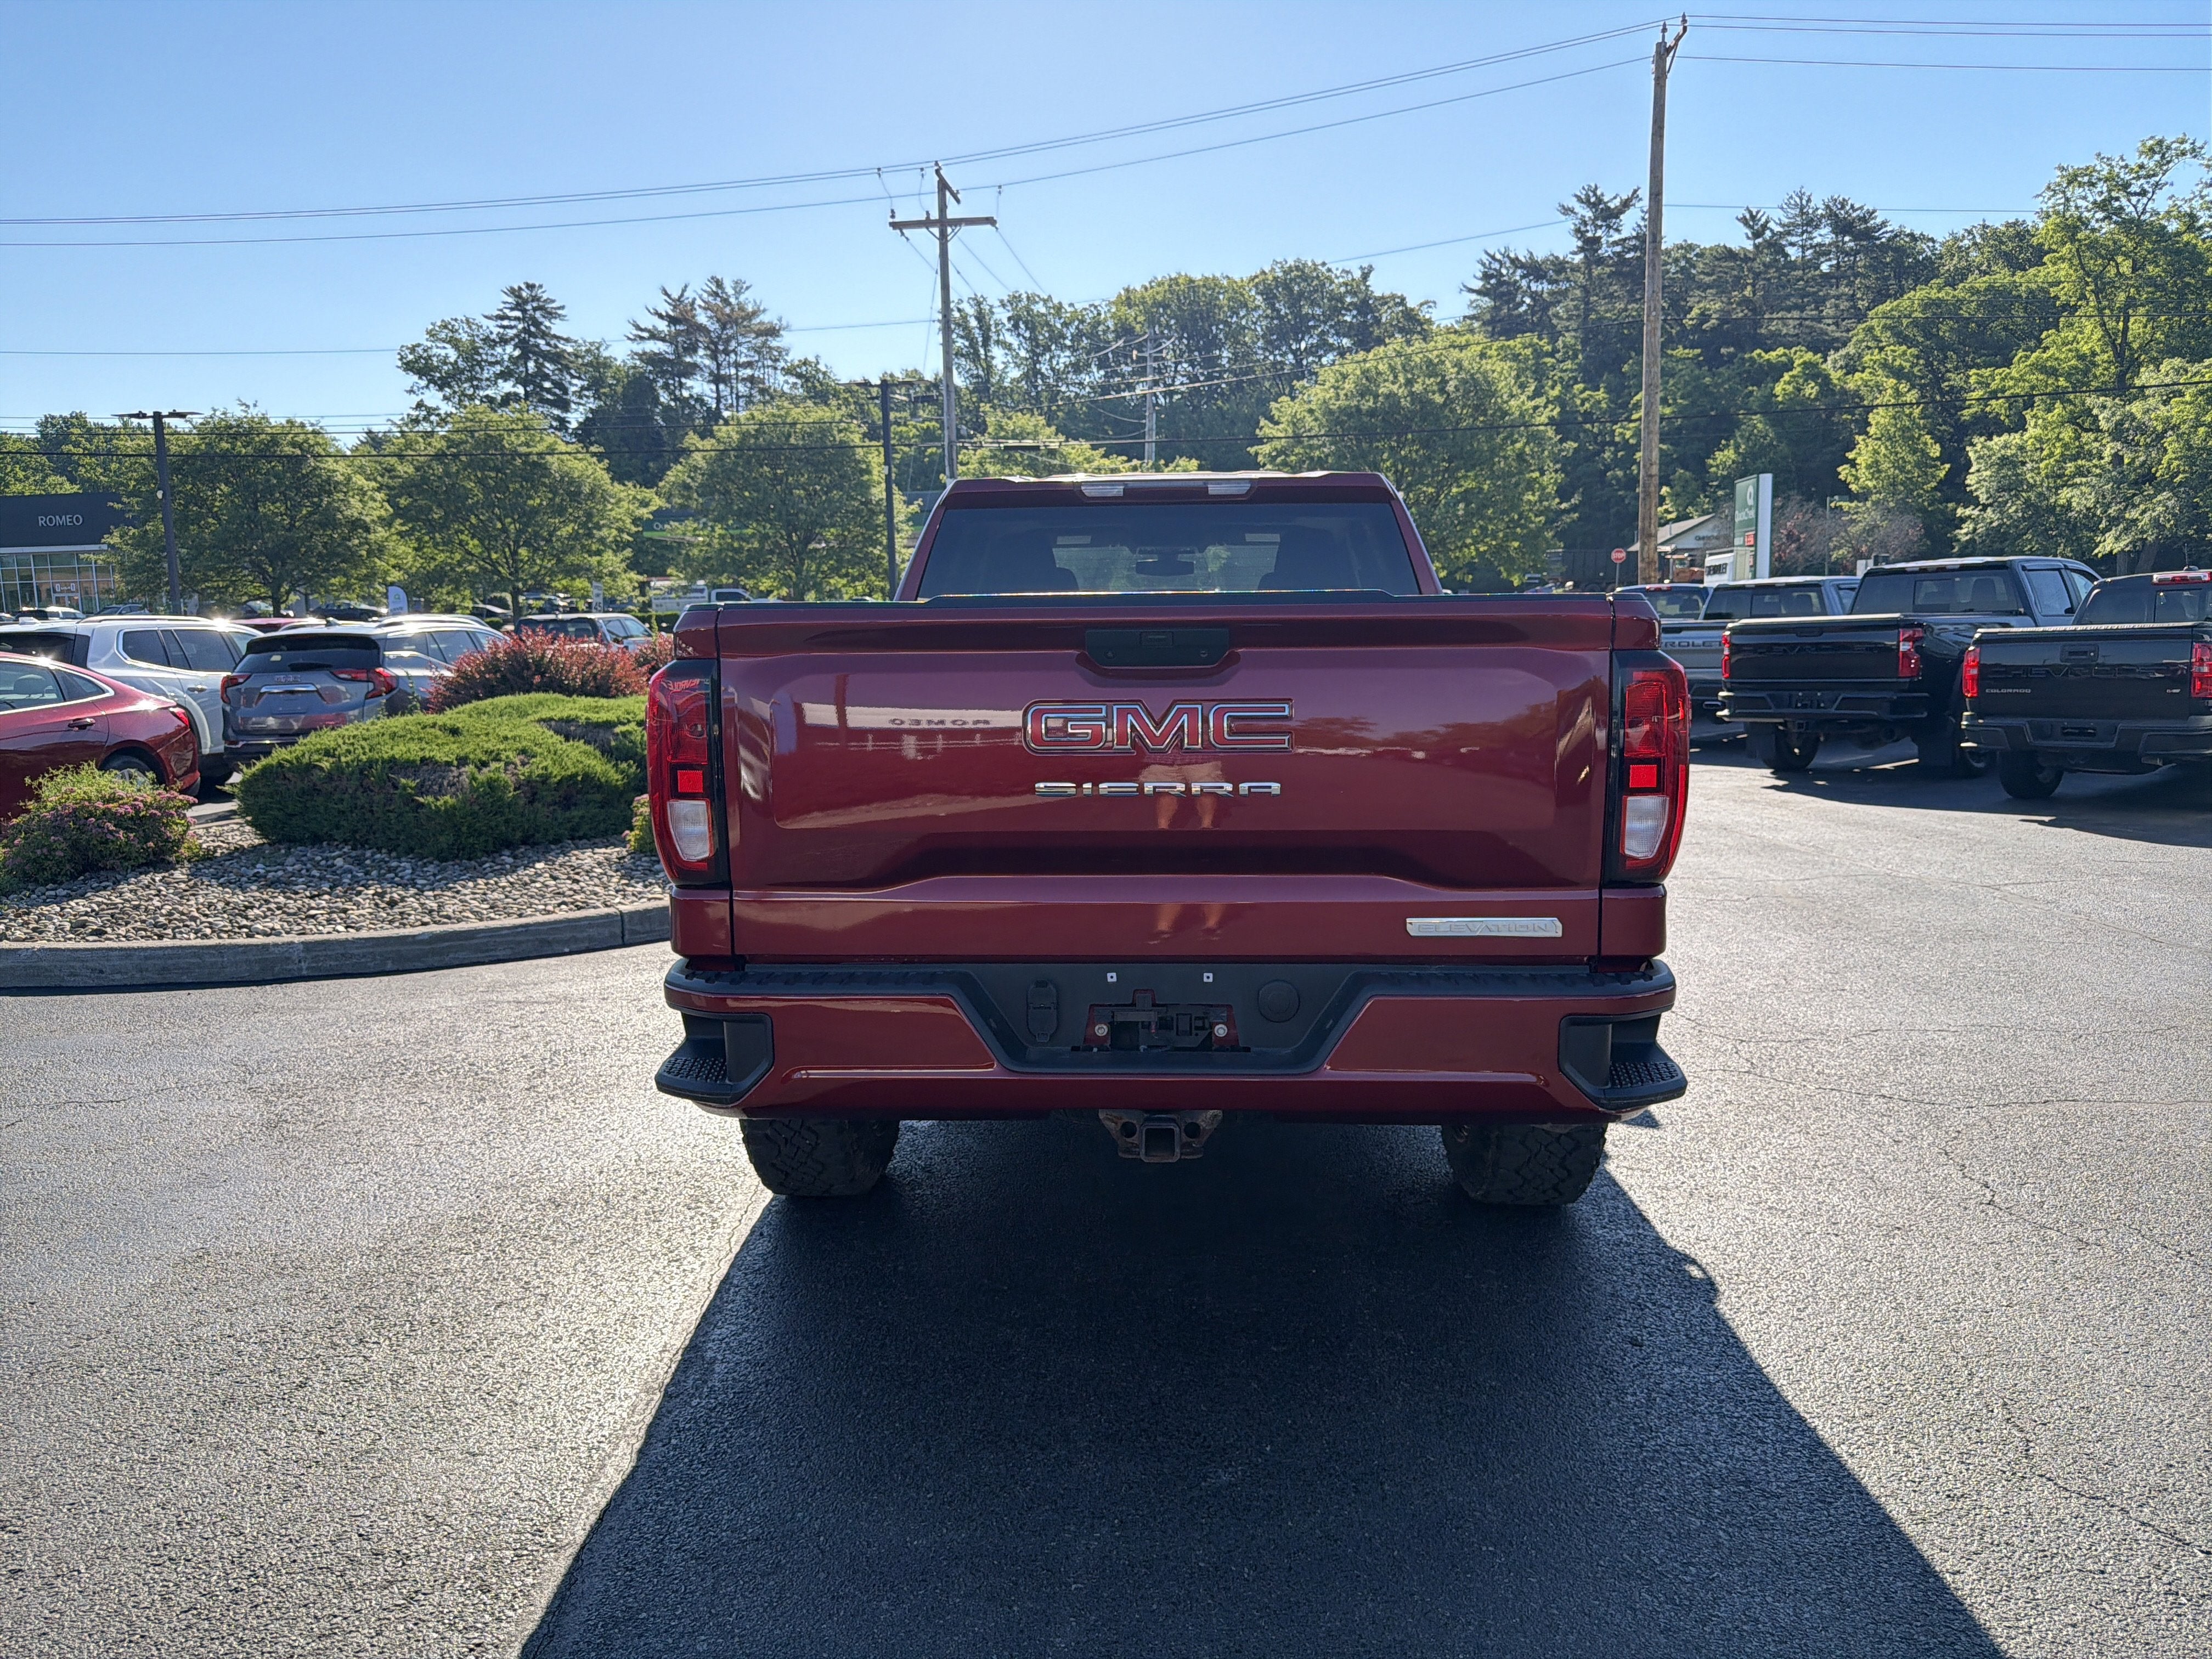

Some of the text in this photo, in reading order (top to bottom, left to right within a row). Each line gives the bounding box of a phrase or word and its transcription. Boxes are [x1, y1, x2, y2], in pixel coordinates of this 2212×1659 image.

[38, 514, 83, 527] ROMEO
[594, 601, 602, 612] 45
[1026, 702, 1293, 753] GMC
[1035, 781, 1282, 798] SIERRA
[1418, 923, 1548, 935] ELEVATION
